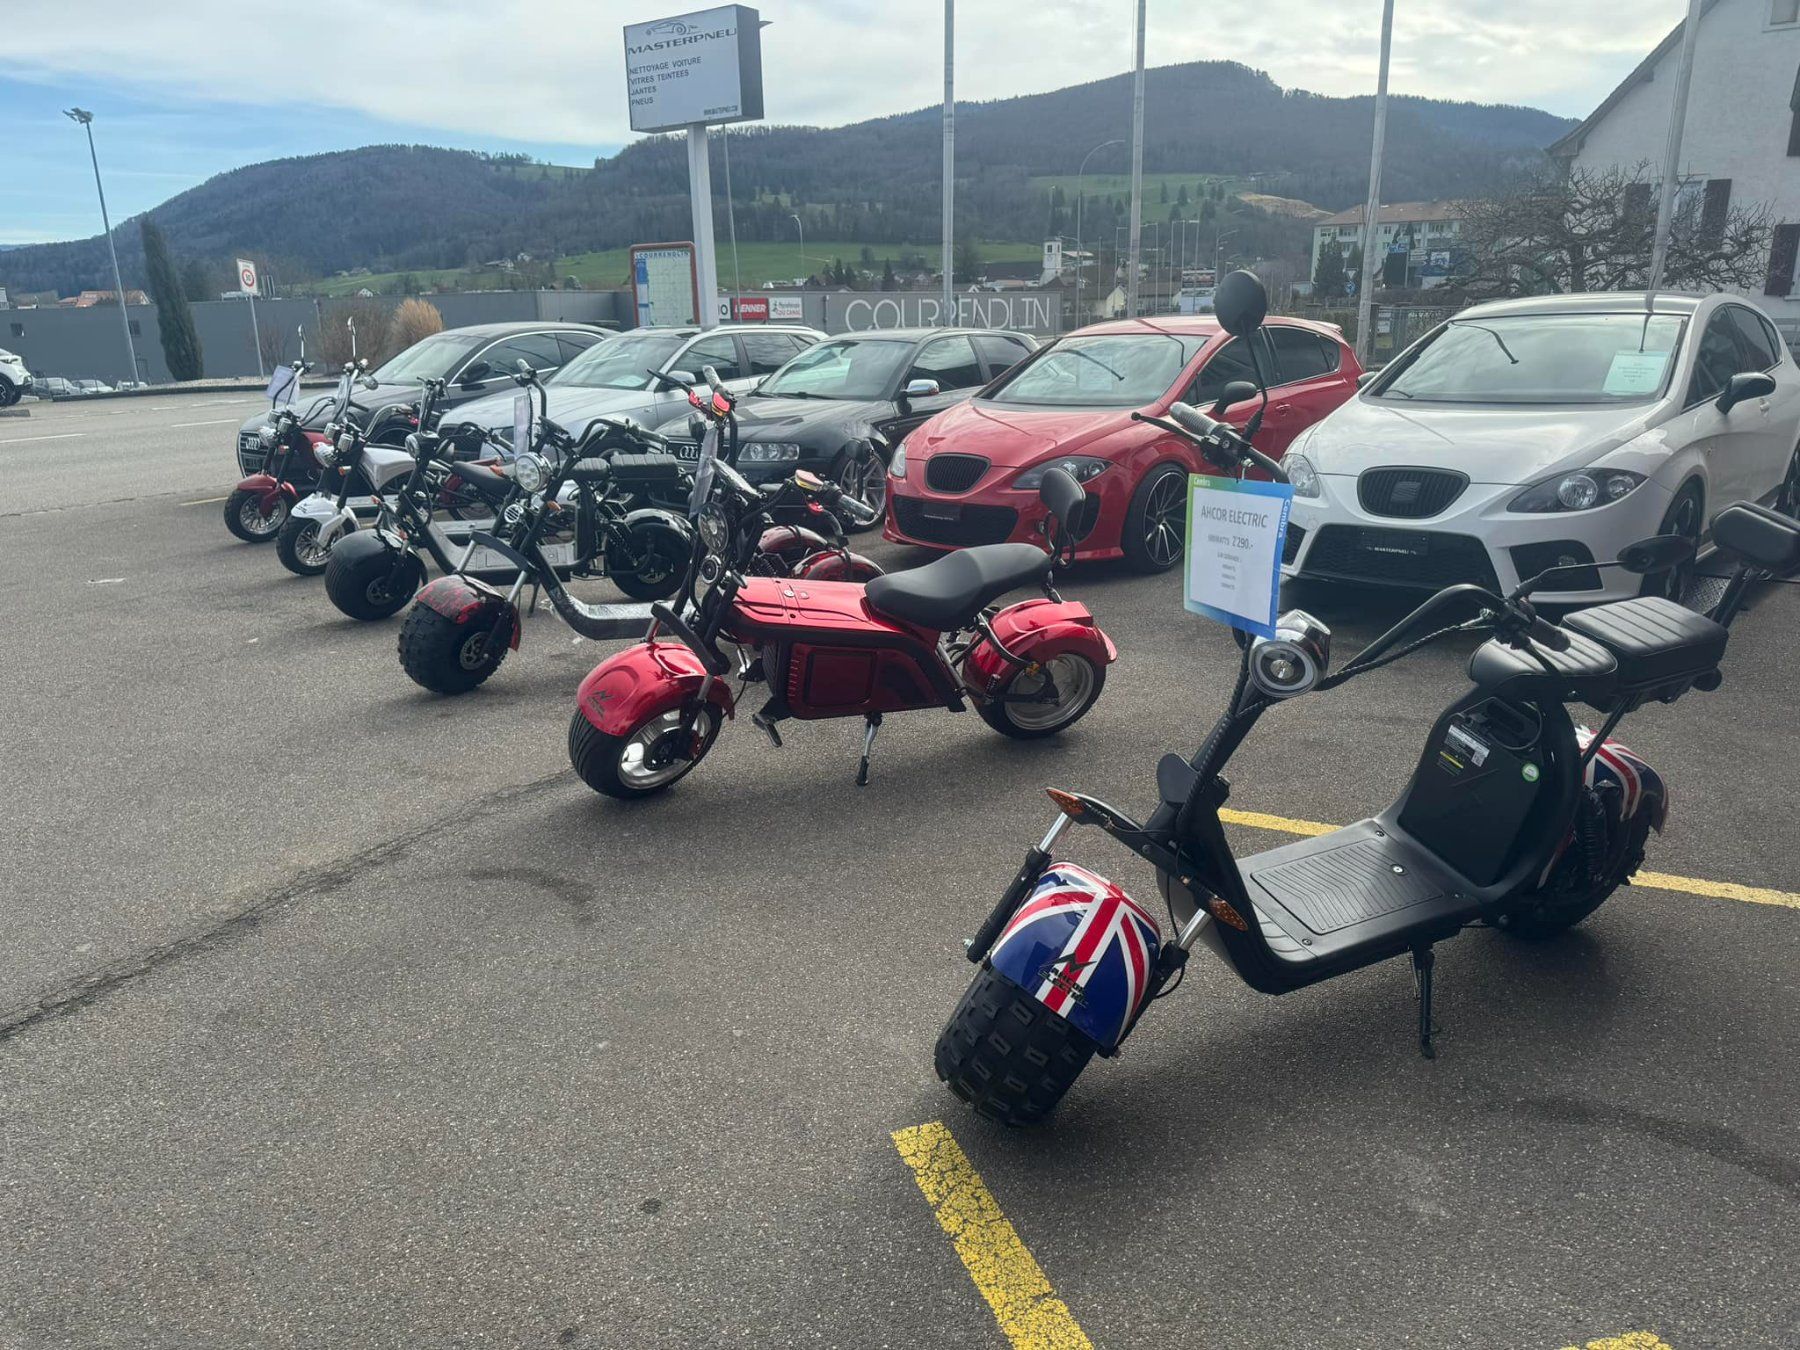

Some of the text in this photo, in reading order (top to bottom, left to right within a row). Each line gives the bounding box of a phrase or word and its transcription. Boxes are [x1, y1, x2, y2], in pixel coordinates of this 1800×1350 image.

[628, 27, 737, 55] MASTERPNEU
[629, 56, 702, 76] NETTOYAGE VOITURE
[630, 69, 689, 86] VITRES TEINTEES
[631, 86, 657, 96] JANTES
[631, 97, 654, 107] PNEUS
[1201, 505, 1269, 528] AHCOR ELECTRIC
[1278, 498, 1291, 538] Cembra
